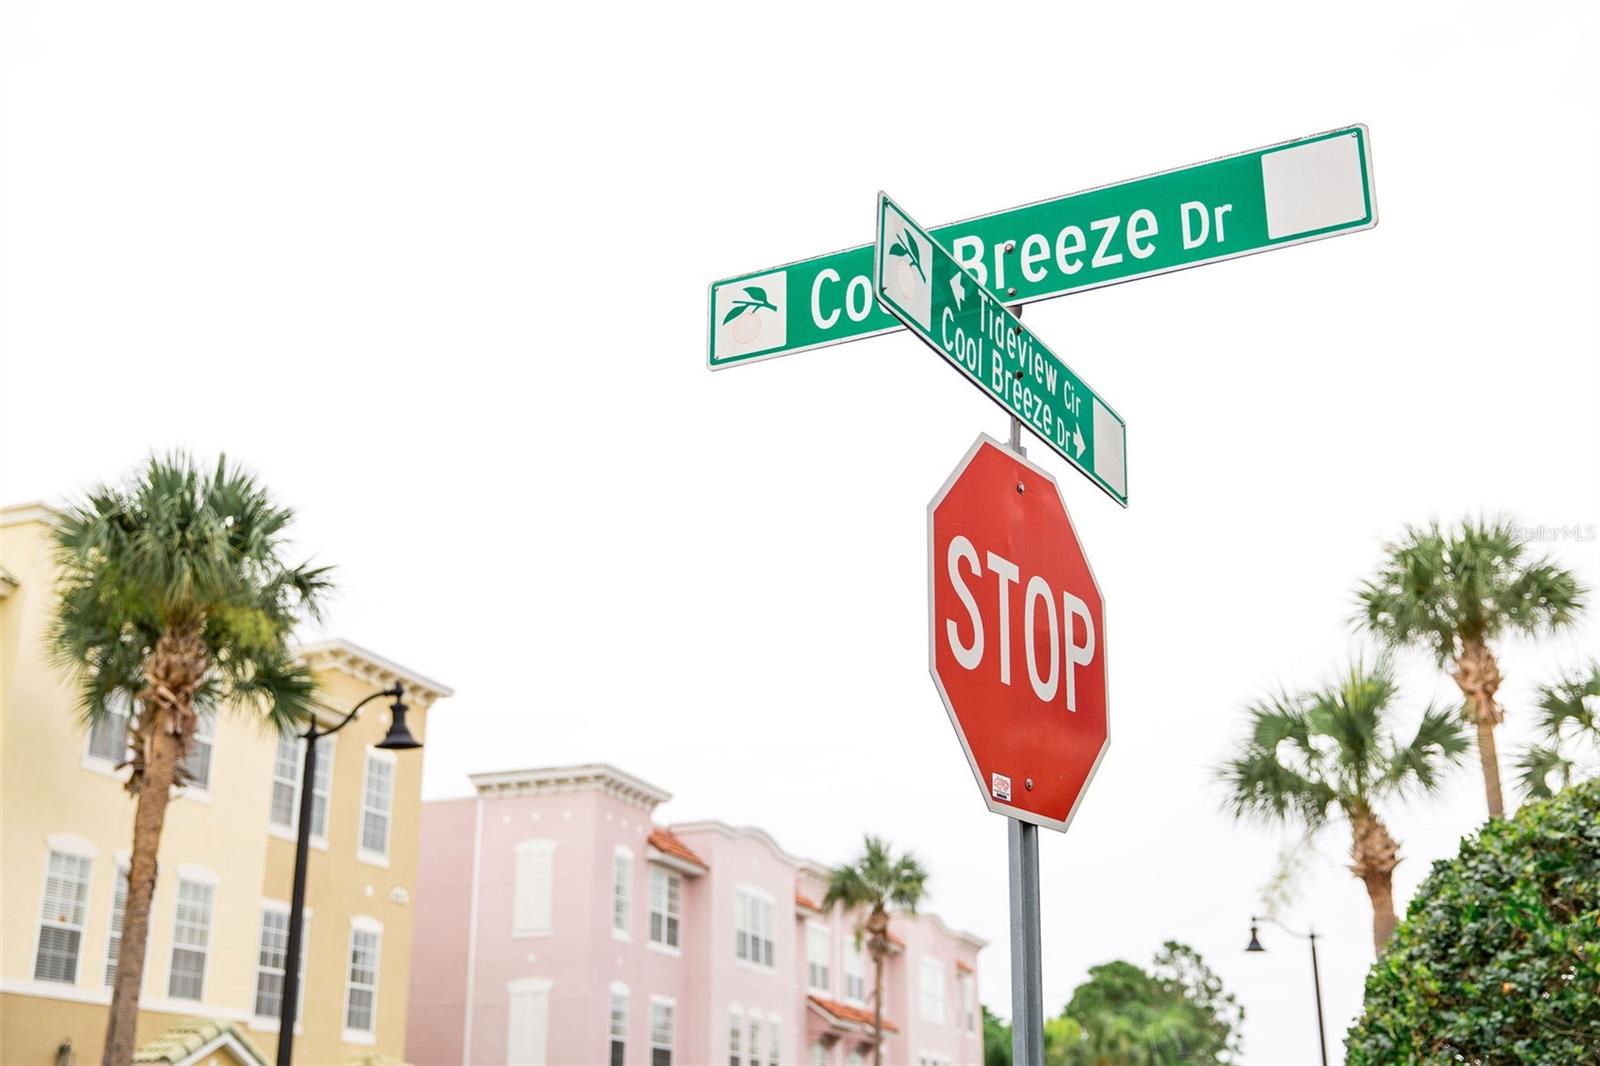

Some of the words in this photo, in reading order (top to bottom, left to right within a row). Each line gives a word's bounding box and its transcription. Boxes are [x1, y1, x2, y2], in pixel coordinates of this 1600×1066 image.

[811, 268, 892, 330] Co
[953, 208, 1159, 290] Breeze
[1180, 200, 1233, 250] Dr
[942, 306, 983, 378] Cool
[992, 348, 1053, 435] Breeze
[1057, 416, 1071, 451] Dr
[977, 289, 1058, 396] Tideview
[1063, 380, 1082, 417] Cir
[946, 535, 1096, 713] STOP
